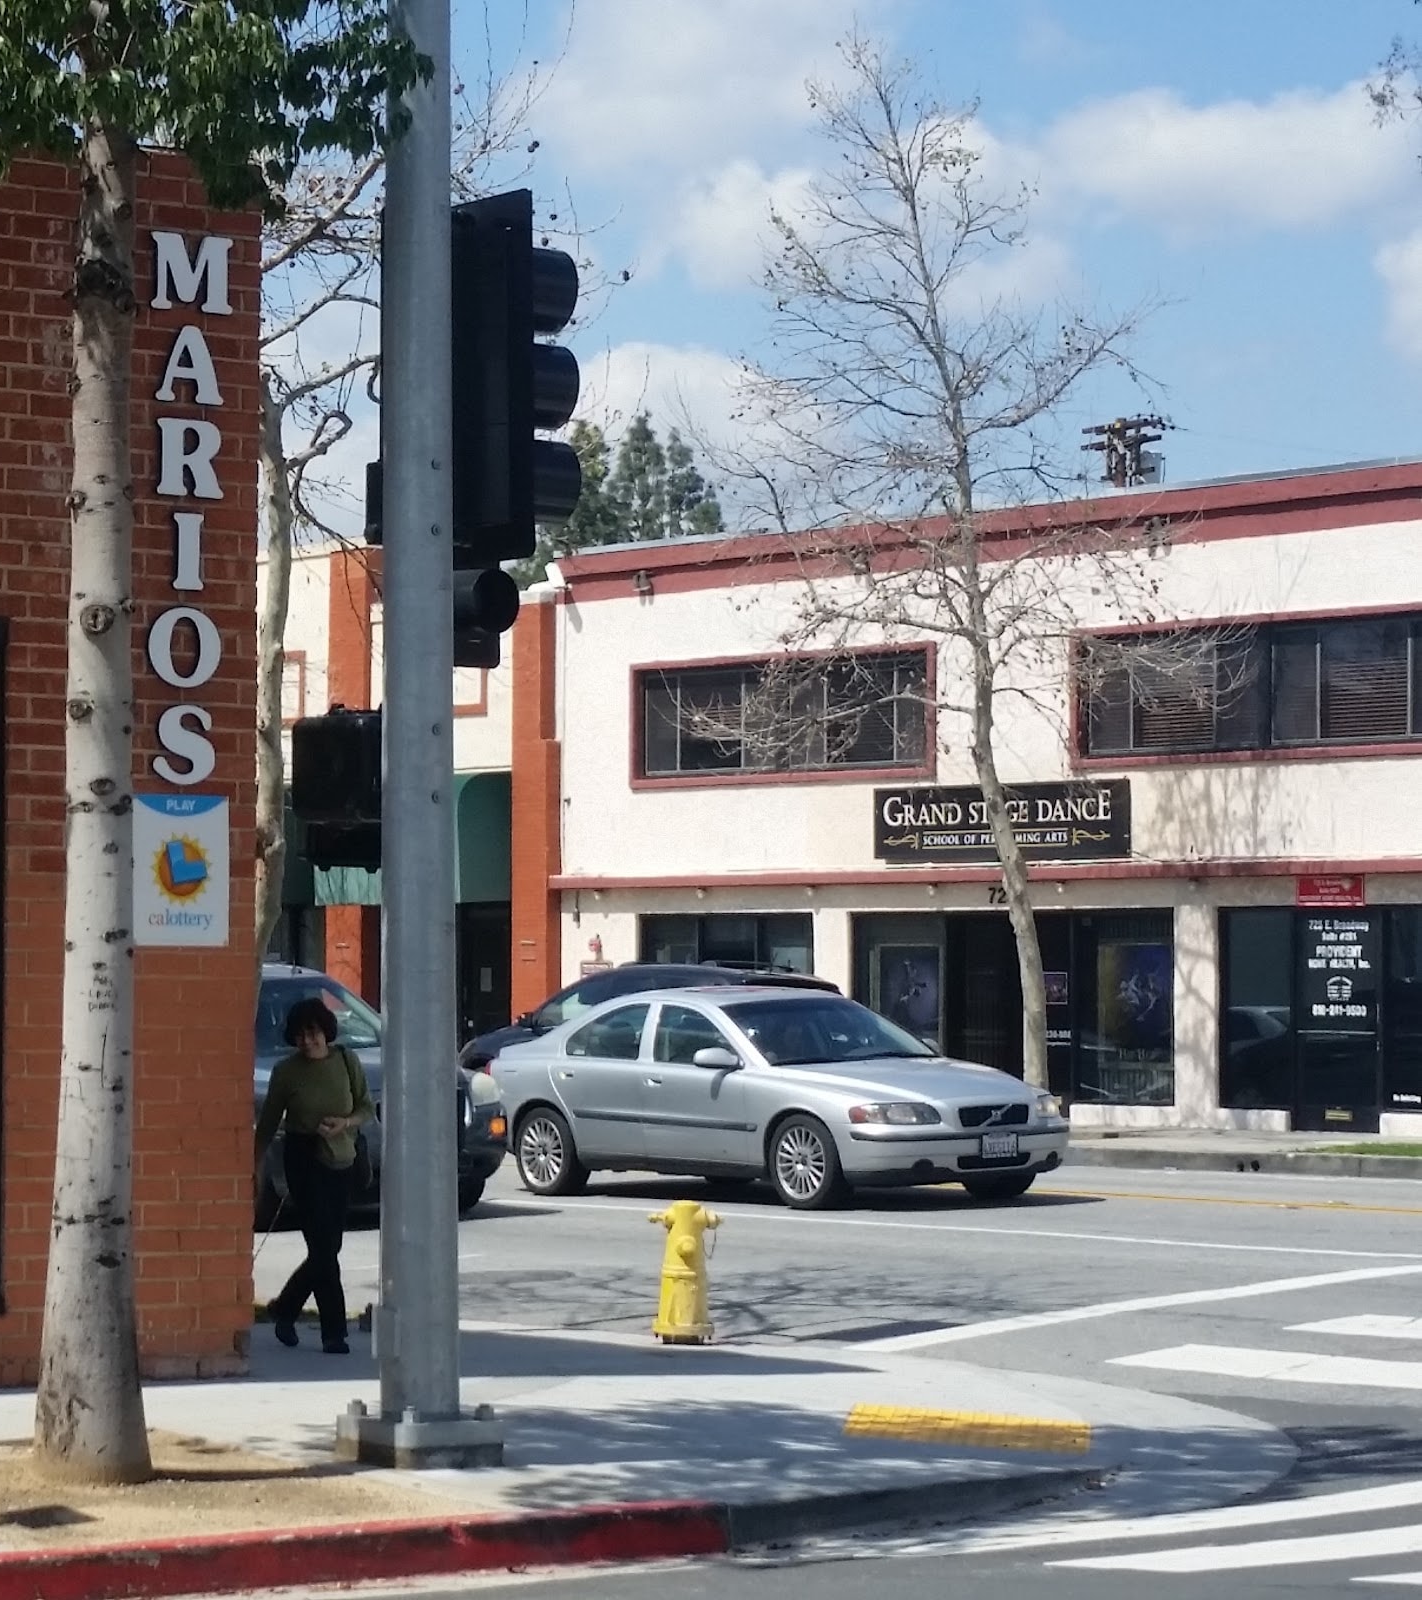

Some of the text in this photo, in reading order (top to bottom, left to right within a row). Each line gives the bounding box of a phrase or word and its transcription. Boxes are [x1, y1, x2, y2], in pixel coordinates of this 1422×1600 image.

[148, 231, 234, 786] MARIOS
[166, 799, 197, 811] PLAY
[882, 789, 1112, 827] GRAND STGE DANCE
[922, 831, 1068, 846] SCHOOL OF PERMING ARTS
[148, 909, 213, 930] calottery
